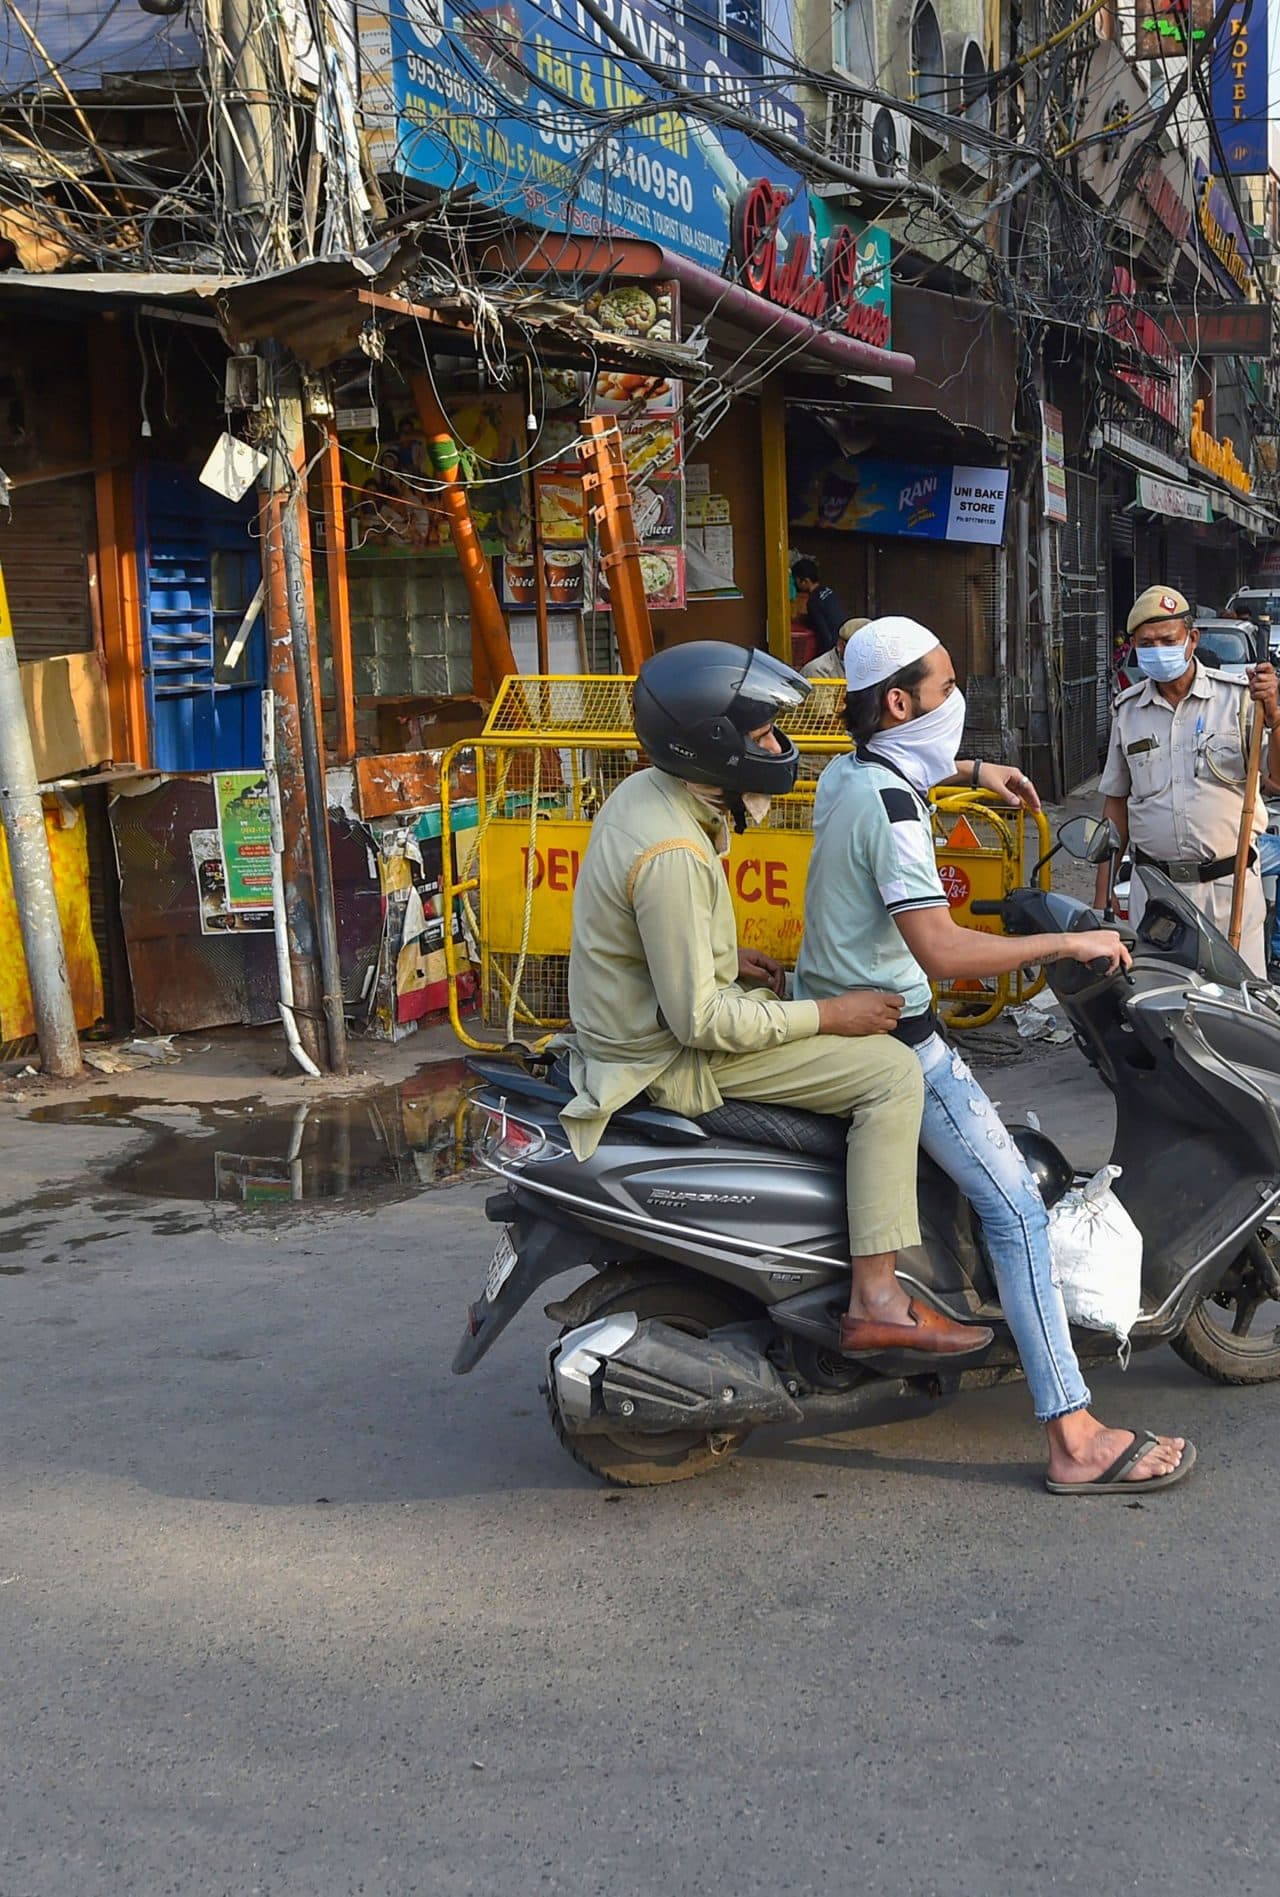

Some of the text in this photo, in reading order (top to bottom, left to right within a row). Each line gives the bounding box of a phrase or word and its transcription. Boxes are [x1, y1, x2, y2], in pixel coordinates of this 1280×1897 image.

[536, 33, 574, 98] Haj
[581, 61, 596, 107] &
[899, 477, 937, 512] RANI
[954, 486, 1004, 500] UNI BAKE
[960, 501, 995, 513] STORE
[508, 575, 534, 588] Swee
[646, 1199, 688, 1208] STREET
